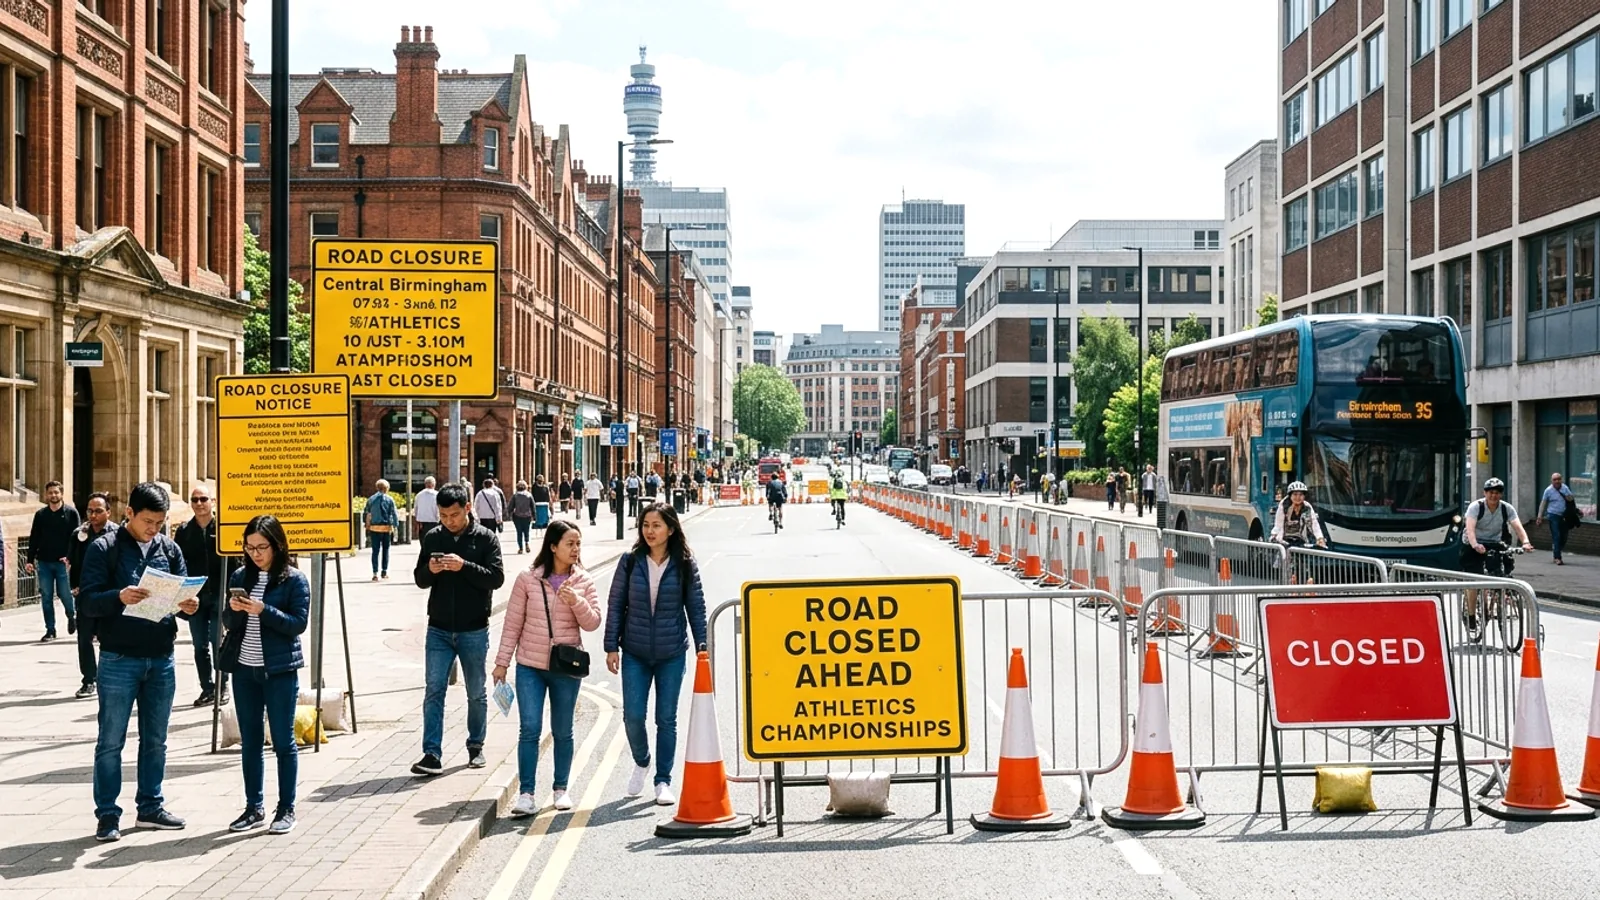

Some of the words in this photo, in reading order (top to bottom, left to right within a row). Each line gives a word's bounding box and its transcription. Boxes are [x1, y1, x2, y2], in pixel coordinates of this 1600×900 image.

[328, 248, 384, 264] ROAD
[389, 249, 483, 265] CLOSURE
[323, 276, 385, 291] Central
[390, 277, 487, 295] Birmingham
[343, 334, 362, 348] 10
[416, 335, 465, 349] 3.10M
[224, 384, 266, 397] ROAD
[270, 382, 342, 396] CLOSURE
[388, 373, 457, 388] CLOSED
[255, 398, 312, 411] NOTICE
[805, 595, 899, 623] ROAD
[784, 627, 921, 656] CLOSED
[1287, 638, 1425, 667] CLOSED
[795, 661, 912, 689] AHEAD
[794, 697, 916, 718] ATHLETICS
[760, 719, 952, 742] CHAMPIONSHIPS
